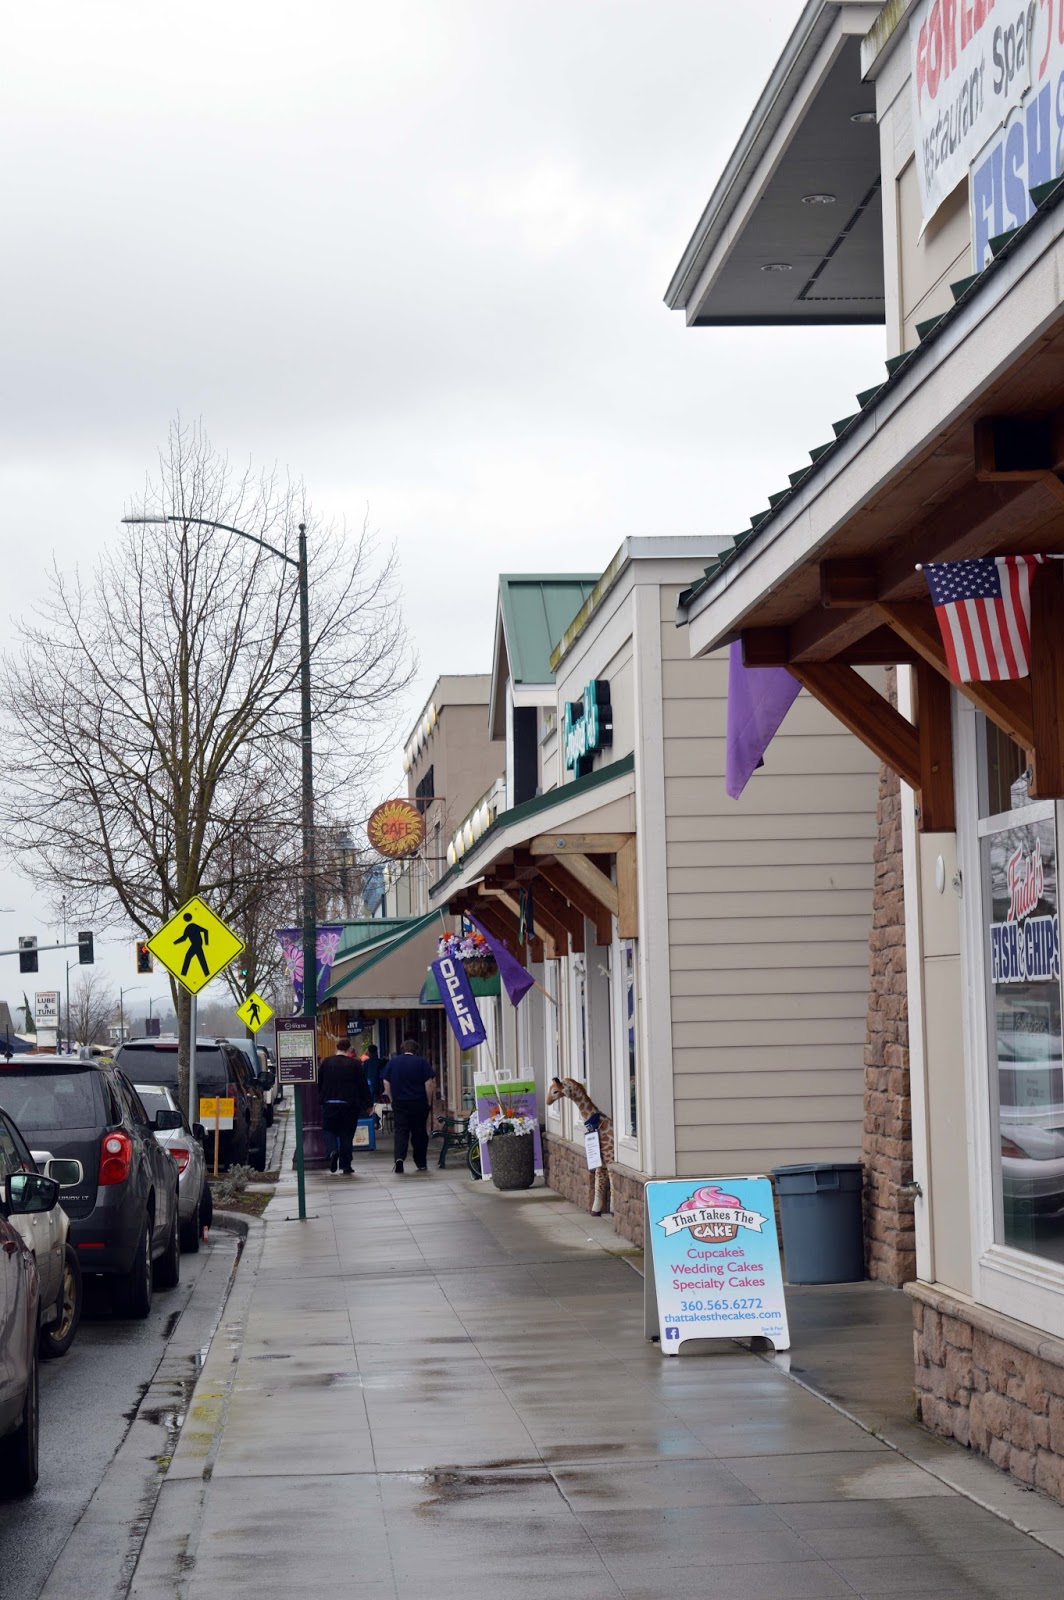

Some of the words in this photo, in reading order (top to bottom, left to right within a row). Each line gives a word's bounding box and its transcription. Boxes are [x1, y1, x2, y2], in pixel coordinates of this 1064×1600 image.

[974, 81, 1051, 272] FISH
[381, 822, 412, 835] CAFE
[991, 924, 1018, 980] FISH
[440, 958, 476, 1036] OPEN
[672, 1213, 697, 1227] That
[699, 1209, 731, 1221] Takes
[734, 1210, 754, 1224] The
[693, 1225, 733, 1238] CAKE
[687, 1248, 745, 1261] Cupcakes
[670, 1263, 725, 1275] Wedding
[727, 1261, 764, 1273] Cakes
[672, 1279, 725, 1291] Specialty
[728, 1276, 765, 1288] Cakes
[681, 1298, 763, 1312] 360.565.6272
[664, 1310, 781, 1323] thattakesthecakes.com
